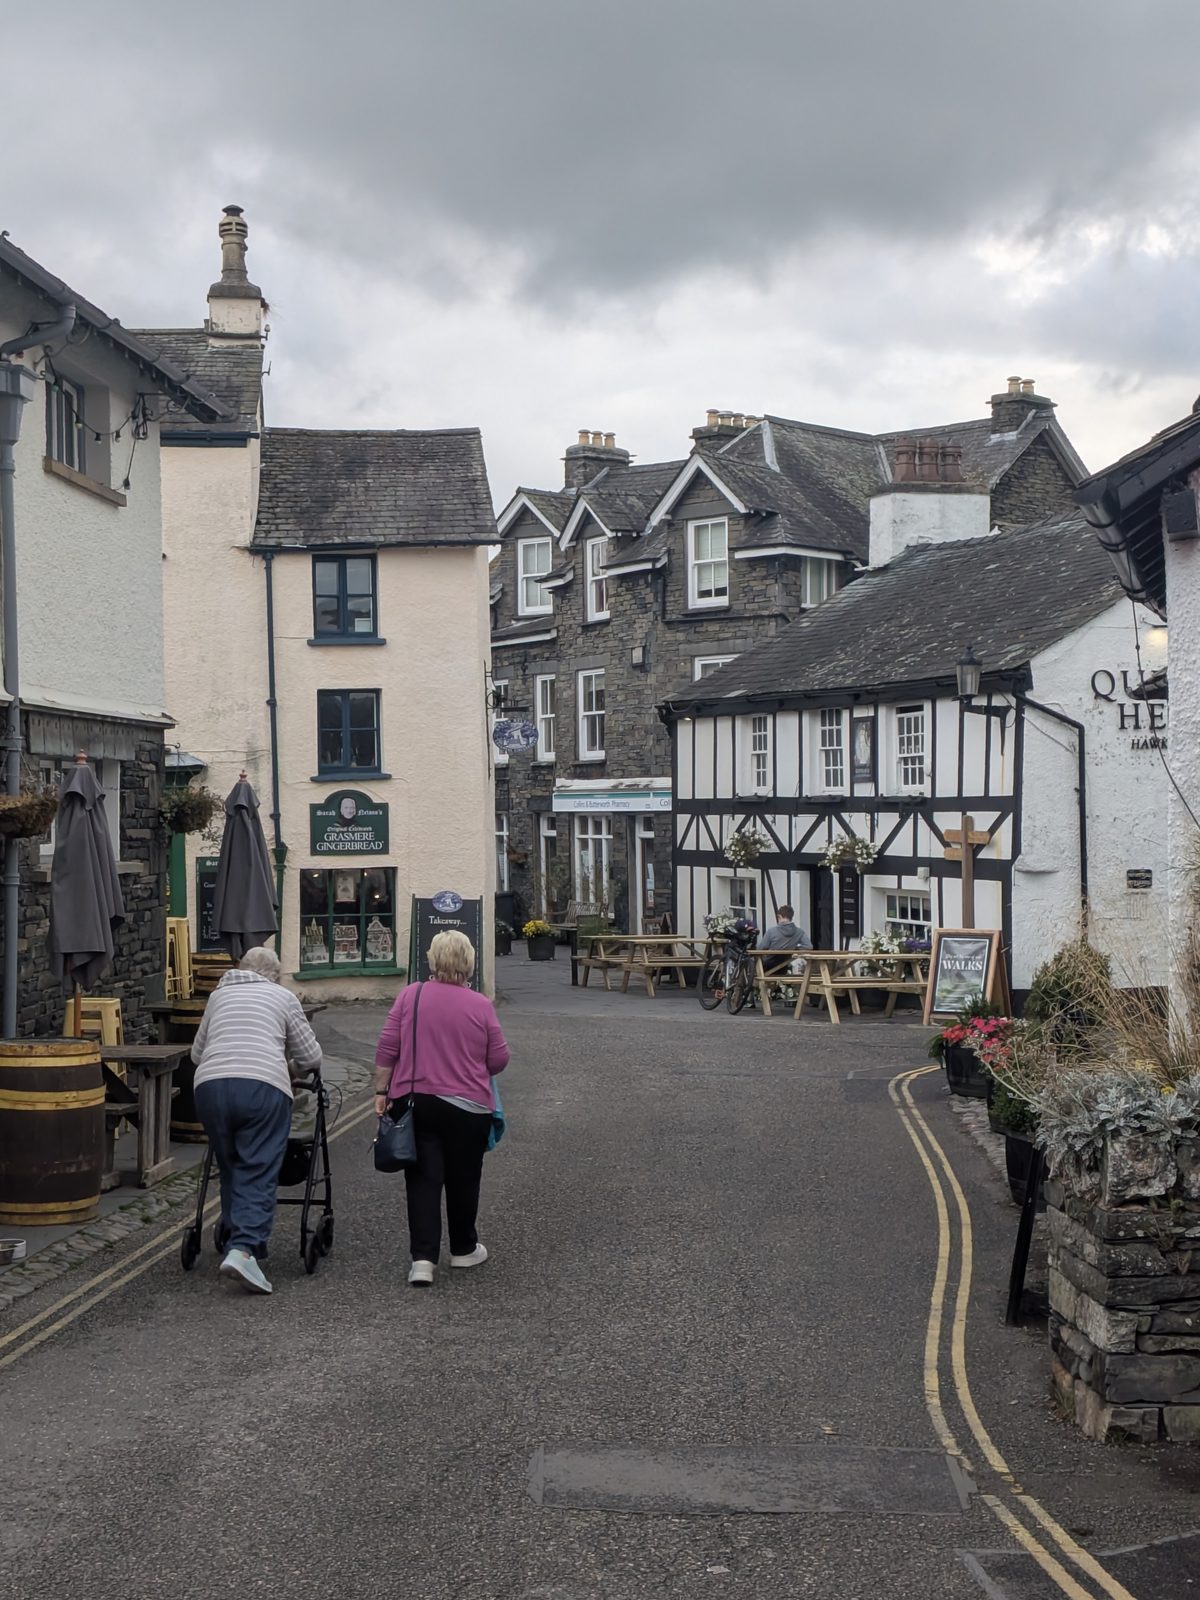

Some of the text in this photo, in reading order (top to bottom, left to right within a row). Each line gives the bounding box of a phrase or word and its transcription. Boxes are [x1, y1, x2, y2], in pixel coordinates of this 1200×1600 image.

[324, 832, 375, 841] GRASMERE
[316, 841, 383, 851] GINGERBREAD
[942, 960, 983, 971] WALKS
